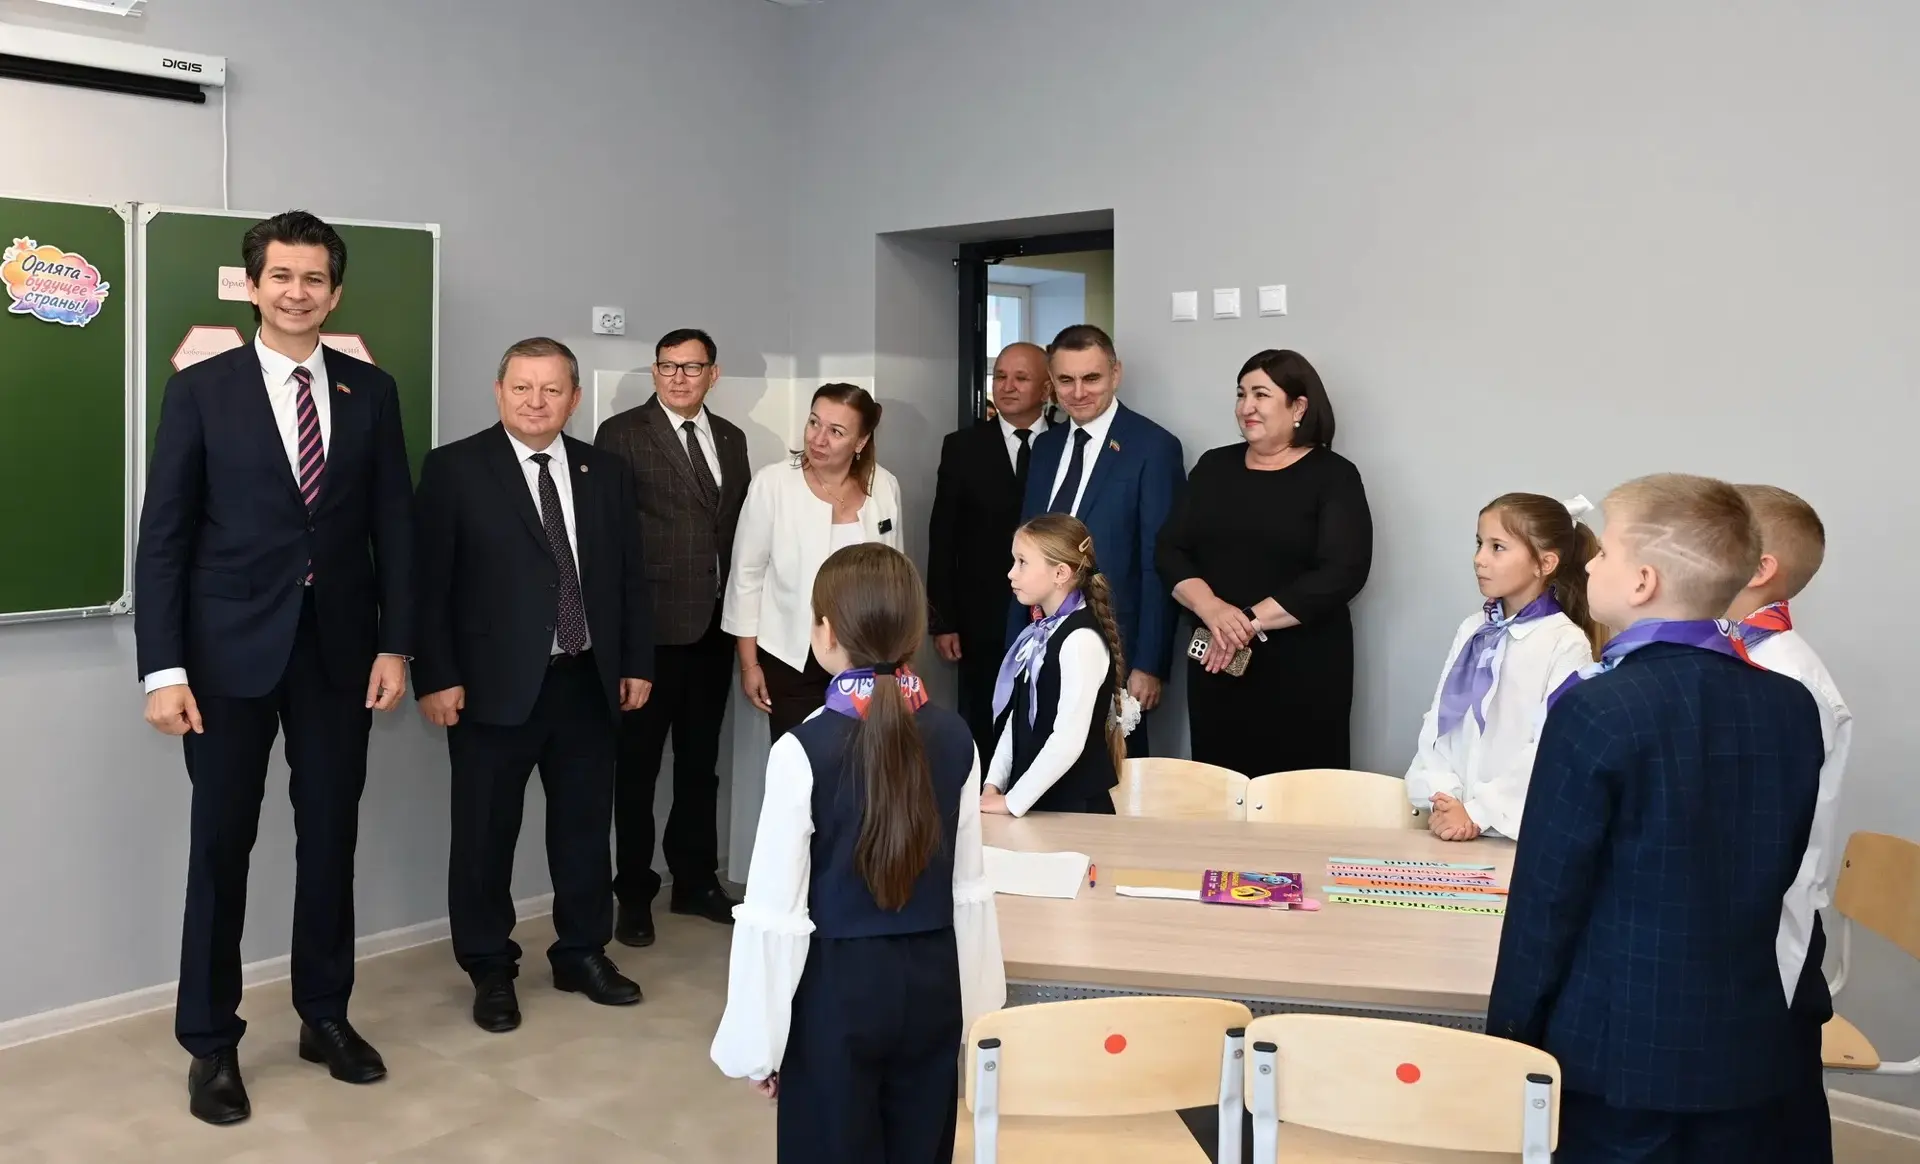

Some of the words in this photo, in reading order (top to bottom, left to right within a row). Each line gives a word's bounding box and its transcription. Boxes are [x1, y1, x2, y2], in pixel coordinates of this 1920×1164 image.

[162, 58, 203, 73] DIGIS
[22, 255, 81, 279] Орлята
[25, 275, 88, 296] будущее
[221, 277, 246, 289] Орлё
[24, 291, 89, 312] страны!
